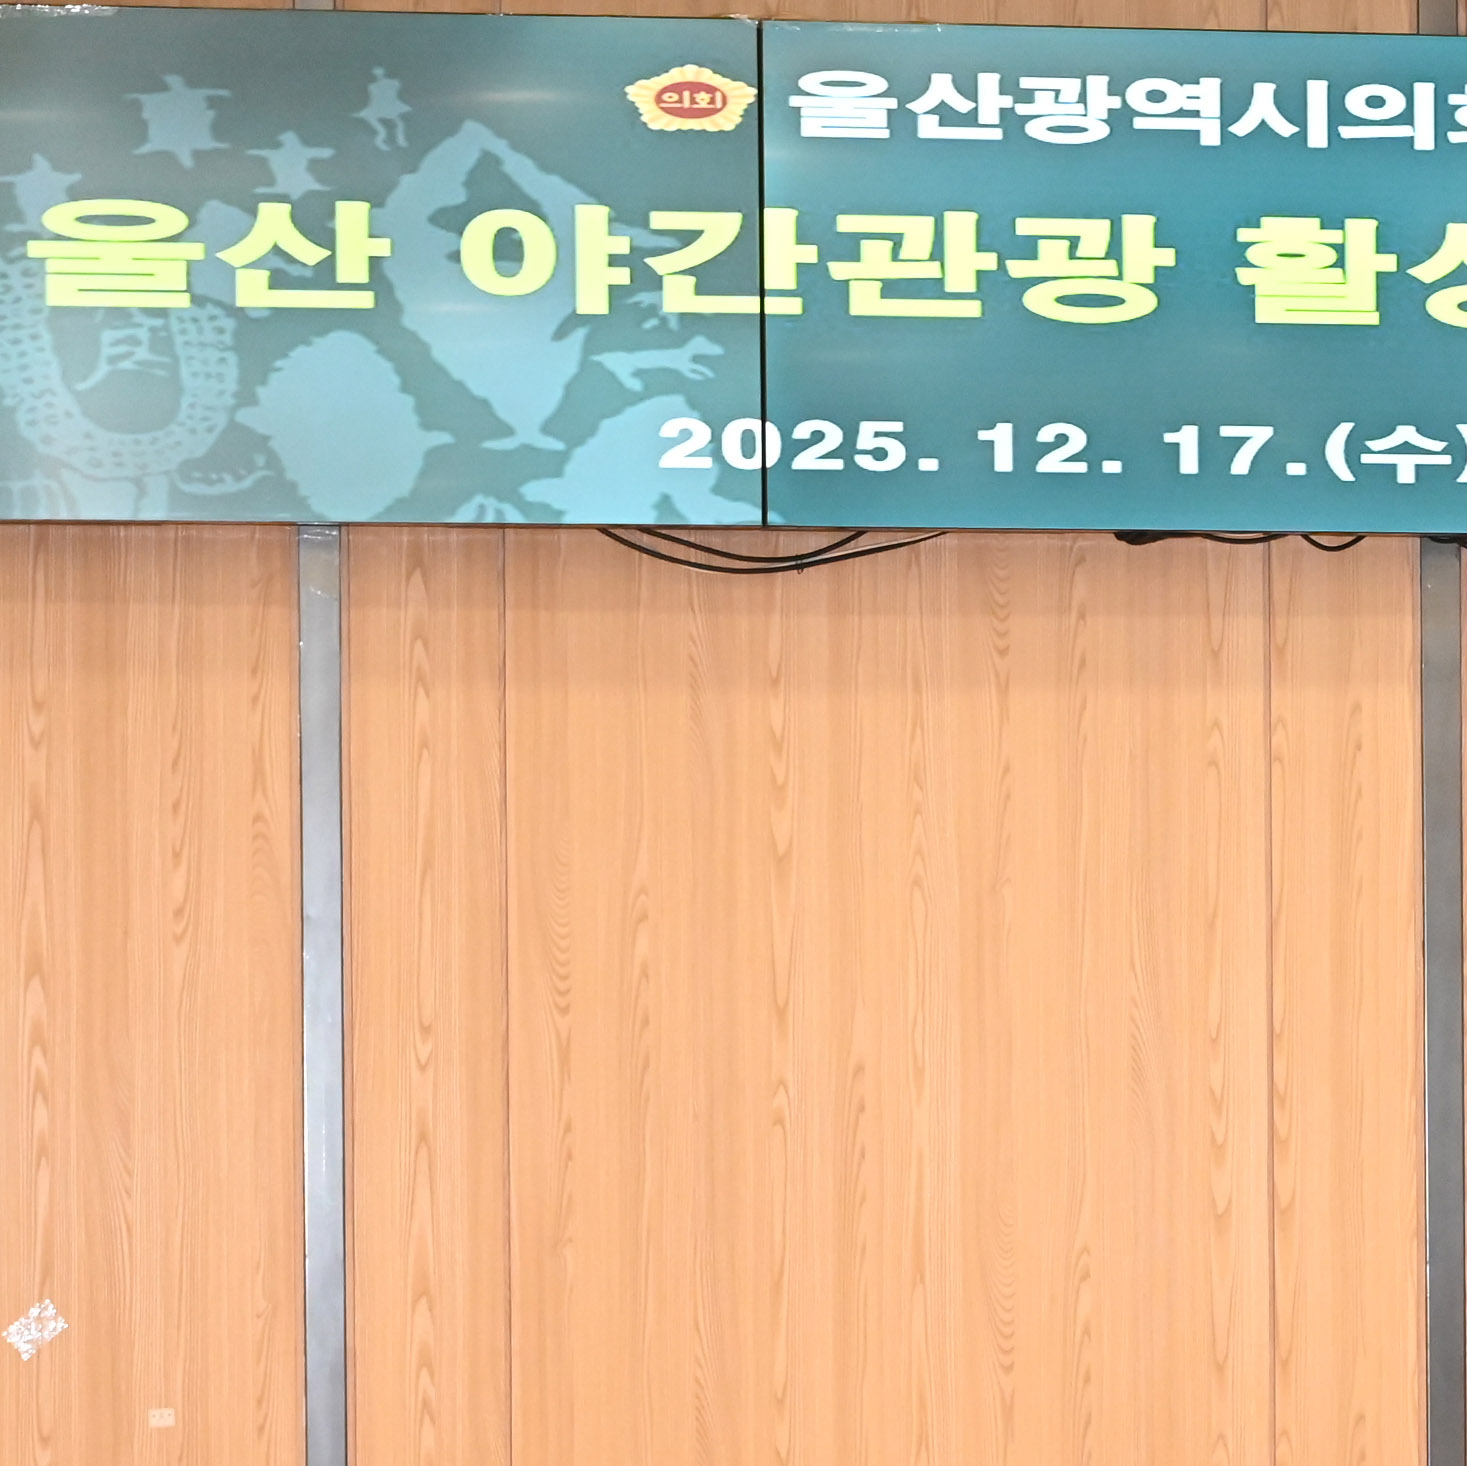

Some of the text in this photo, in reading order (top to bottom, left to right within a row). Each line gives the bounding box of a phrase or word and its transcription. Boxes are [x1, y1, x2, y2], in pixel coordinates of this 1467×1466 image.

[659, 90, 723, 109] 의회
[25, 198, 393, 309] 울산
[459, 204, 1177, 325] 야간관광
[658, 417, 939, 472] 2025.
[978, 422, 1122, 473] 12.
